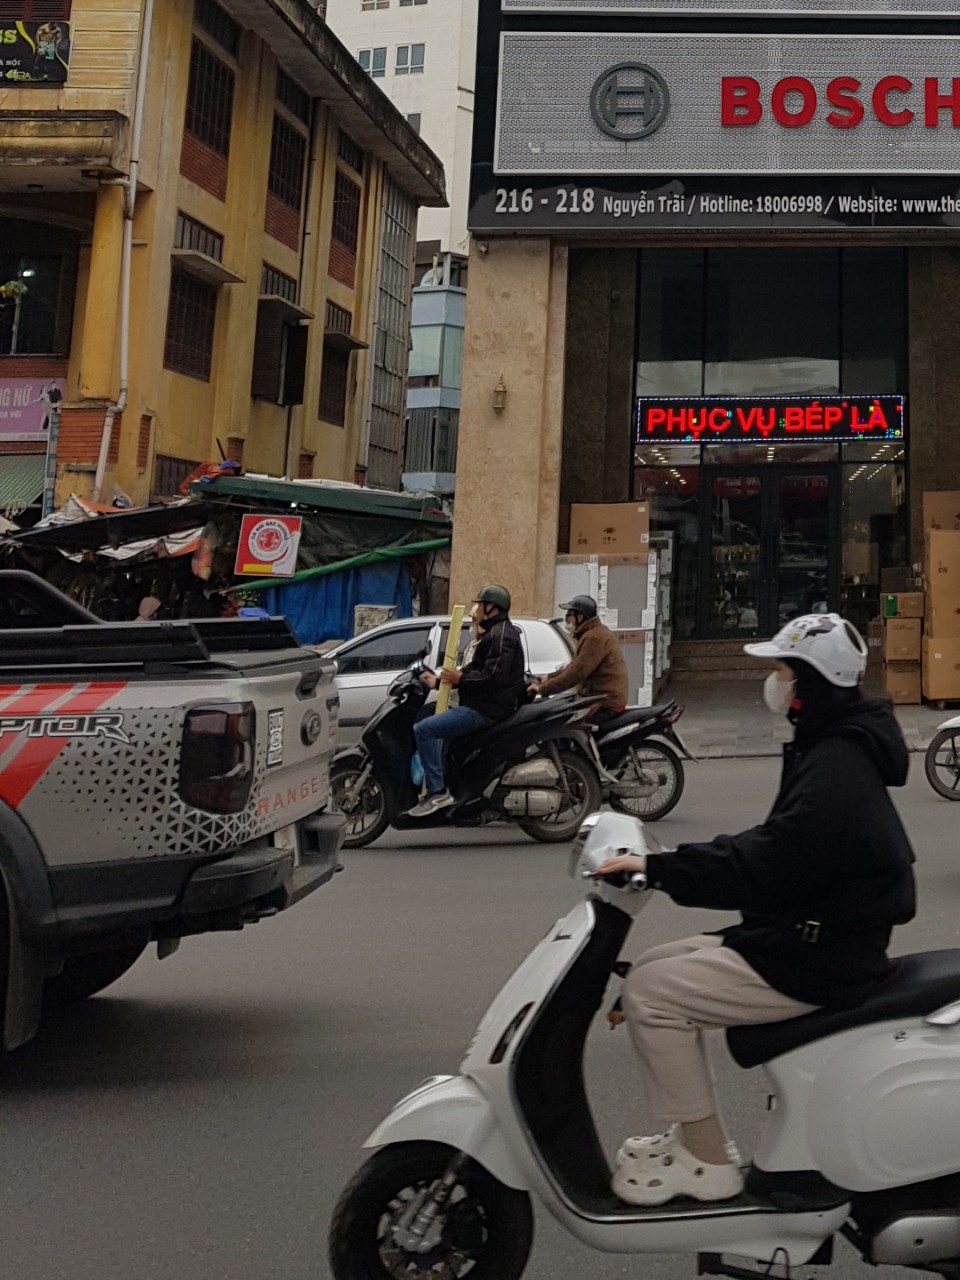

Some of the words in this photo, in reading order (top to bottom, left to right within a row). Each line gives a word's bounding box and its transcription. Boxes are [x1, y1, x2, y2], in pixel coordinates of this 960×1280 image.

[495, 188, 534, 214] 216
[555, 188, 595, 214] 218
[603, 190, 655, 218] Nguyễn
[658, 194, 685, 214] Trãi
[700, 195, 754, 214] Hotline:
[756, 195, 823, 214] 18006998
[838, 195, 898, 214] Website:
[737, 407, 776, 437] VỤ
[784, 401, 843, 431] BẾP
